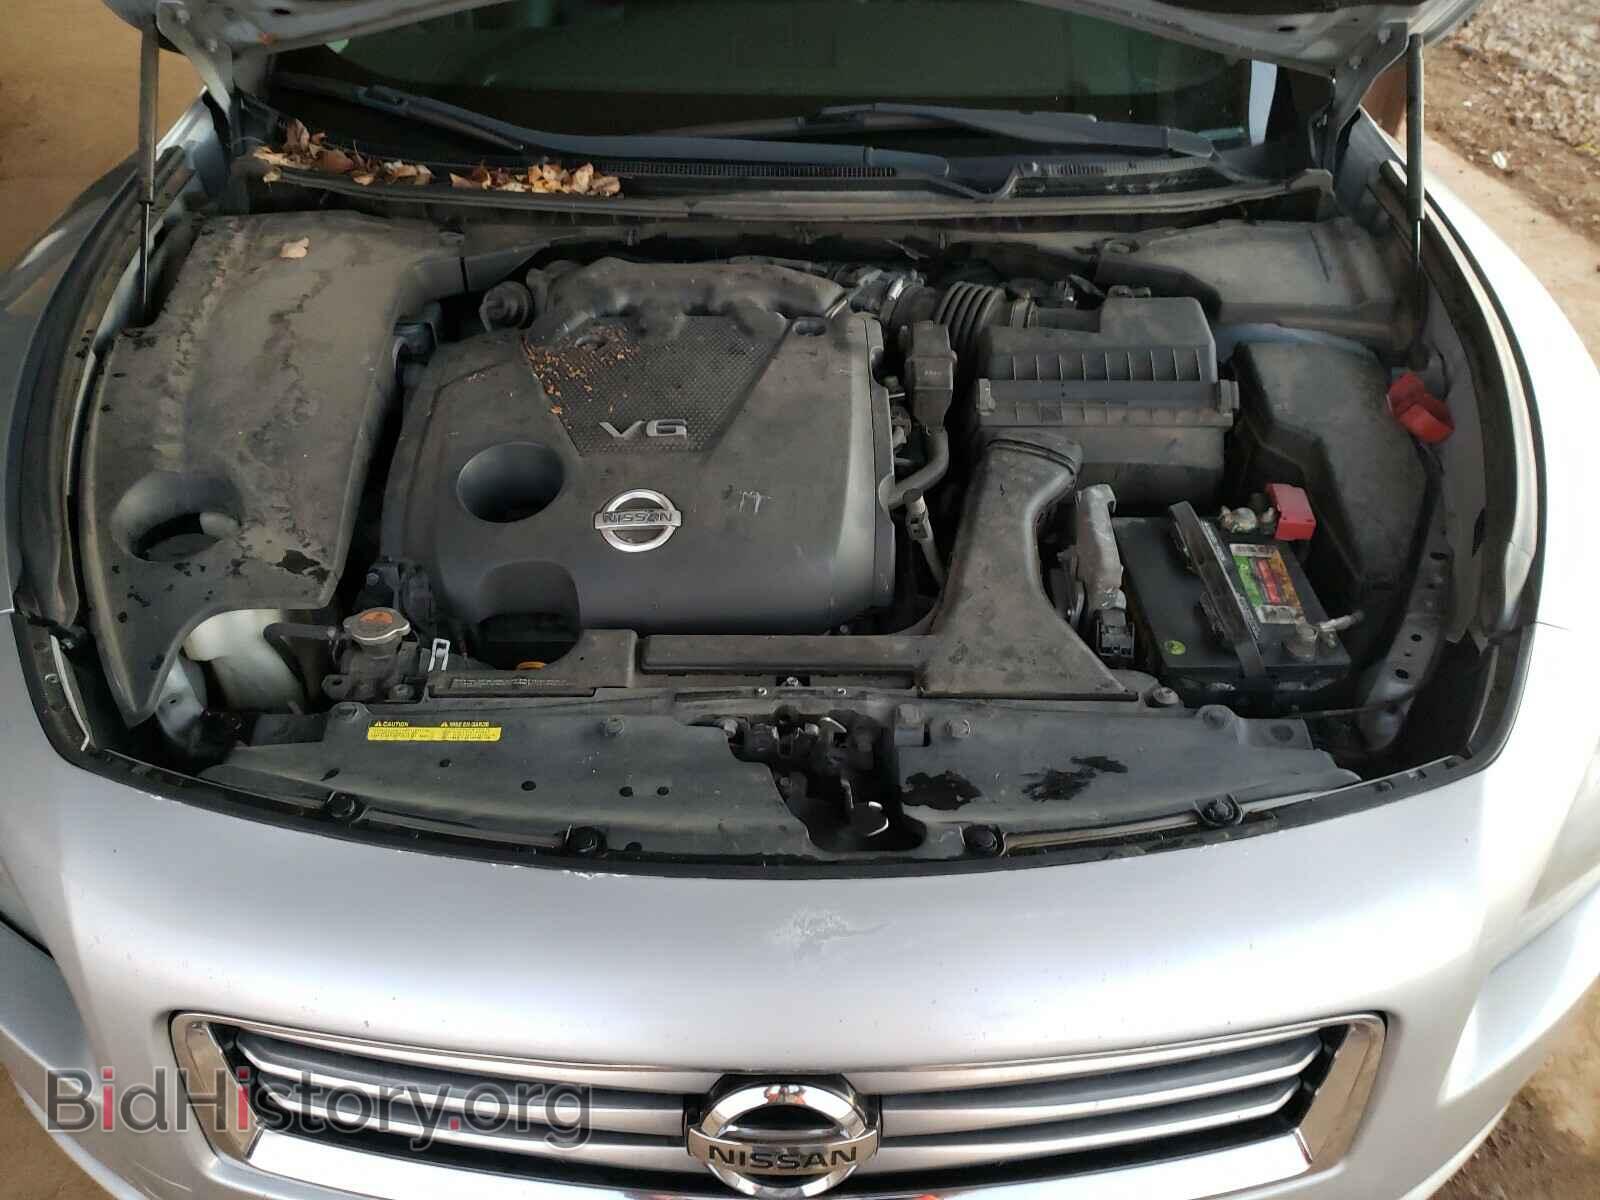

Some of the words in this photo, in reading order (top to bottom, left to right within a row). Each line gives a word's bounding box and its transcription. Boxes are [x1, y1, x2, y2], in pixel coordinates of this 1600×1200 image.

[599, 418, 688, 441] V6
[602, 511, 672, 523] NISSAN
[708, 1144, 858, 1171] NISSAN
